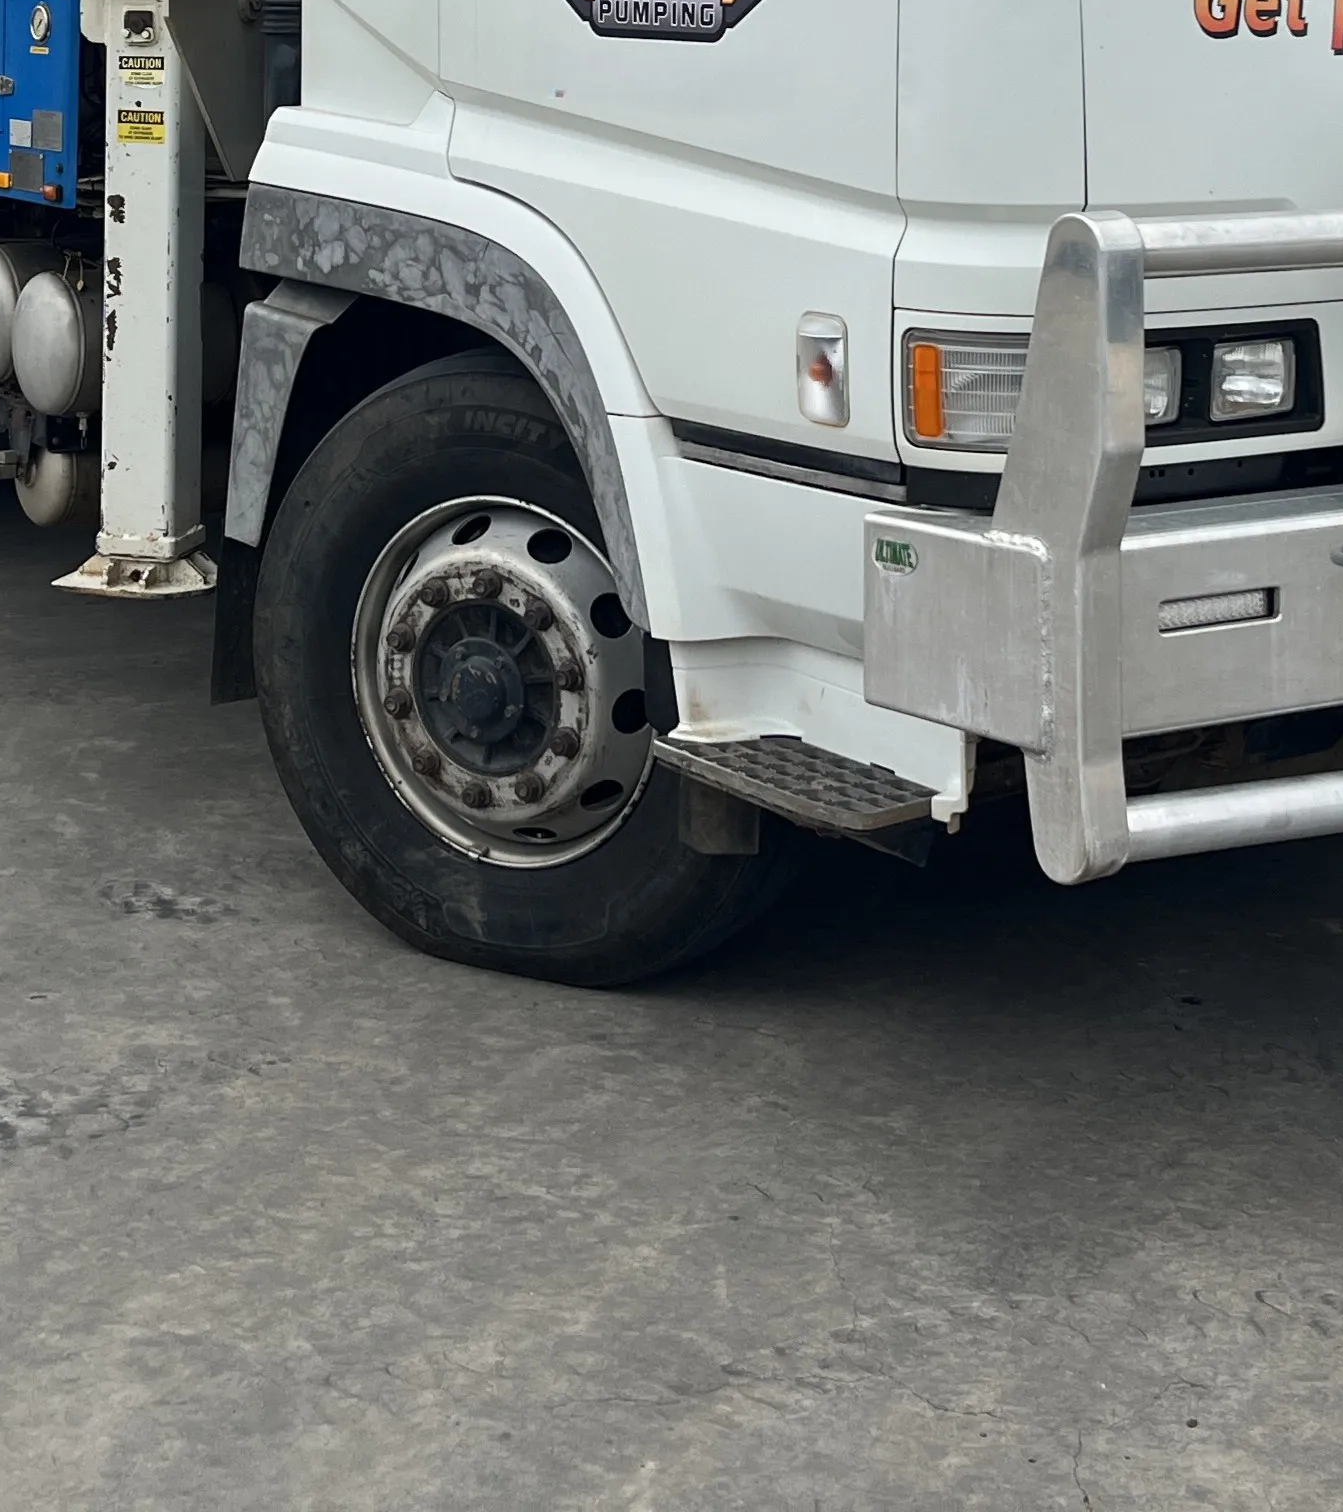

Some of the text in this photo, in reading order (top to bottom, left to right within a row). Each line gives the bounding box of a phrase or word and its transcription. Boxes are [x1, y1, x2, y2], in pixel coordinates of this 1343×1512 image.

[598, 0, 715, 27] PUMPING
[121, 57, 162, 69] CAUTION
[120, 111, 162, 123] CAUTION
